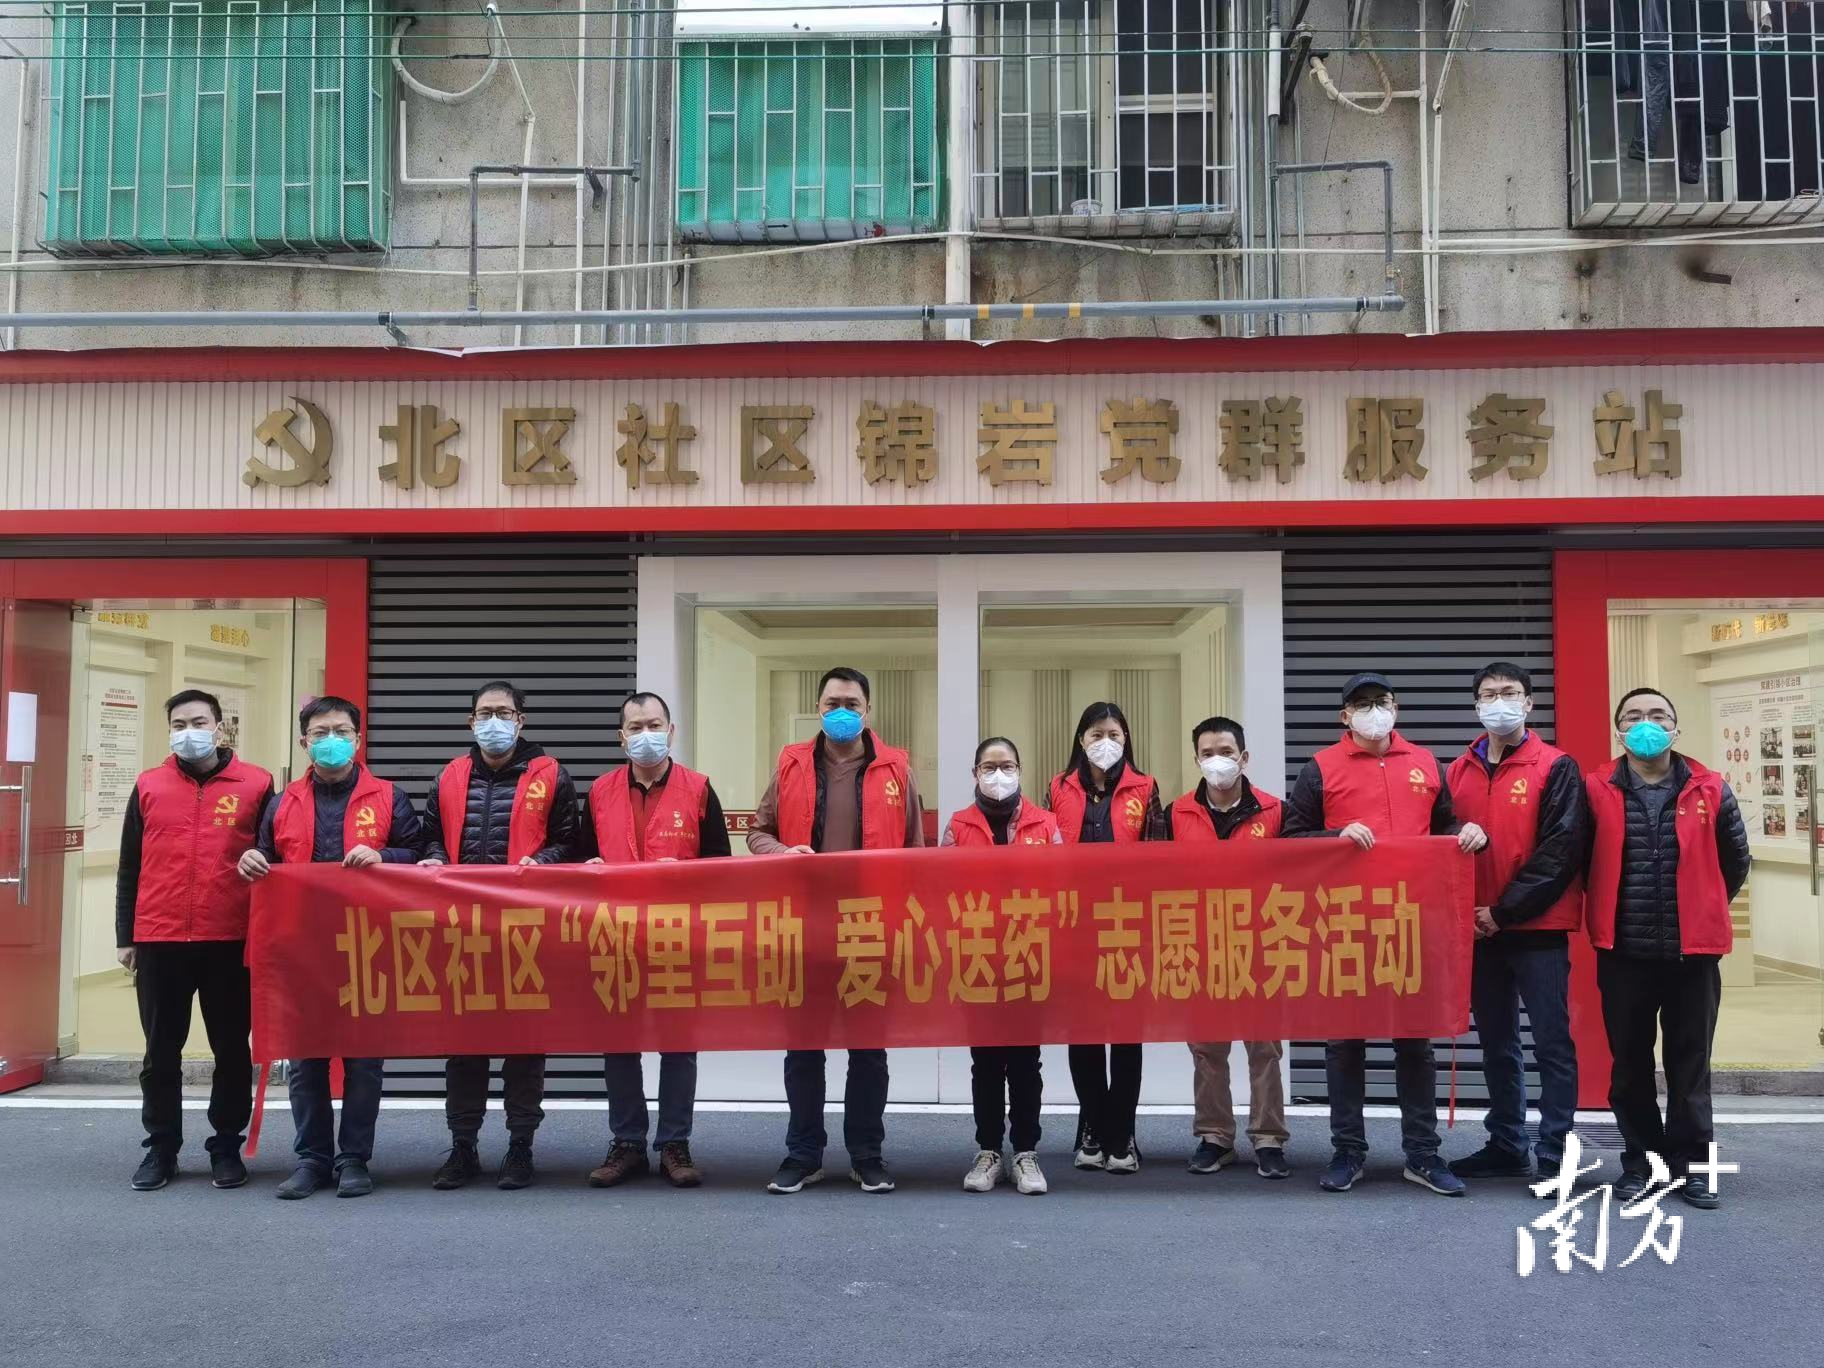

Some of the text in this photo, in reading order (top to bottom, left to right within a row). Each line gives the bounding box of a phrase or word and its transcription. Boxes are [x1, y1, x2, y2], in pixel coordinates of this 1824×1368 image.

[378, 388, 1683, 486] 北区社区锦岩党群服务站
[525, 802, 544, 811] 北区
[213, 817, 237, 826] 北区
[356, 828, 377, 838] 北区
[335, 881, 1422, 1017] 北区社区“邻里互助 爱心送药”志愿服务活动
